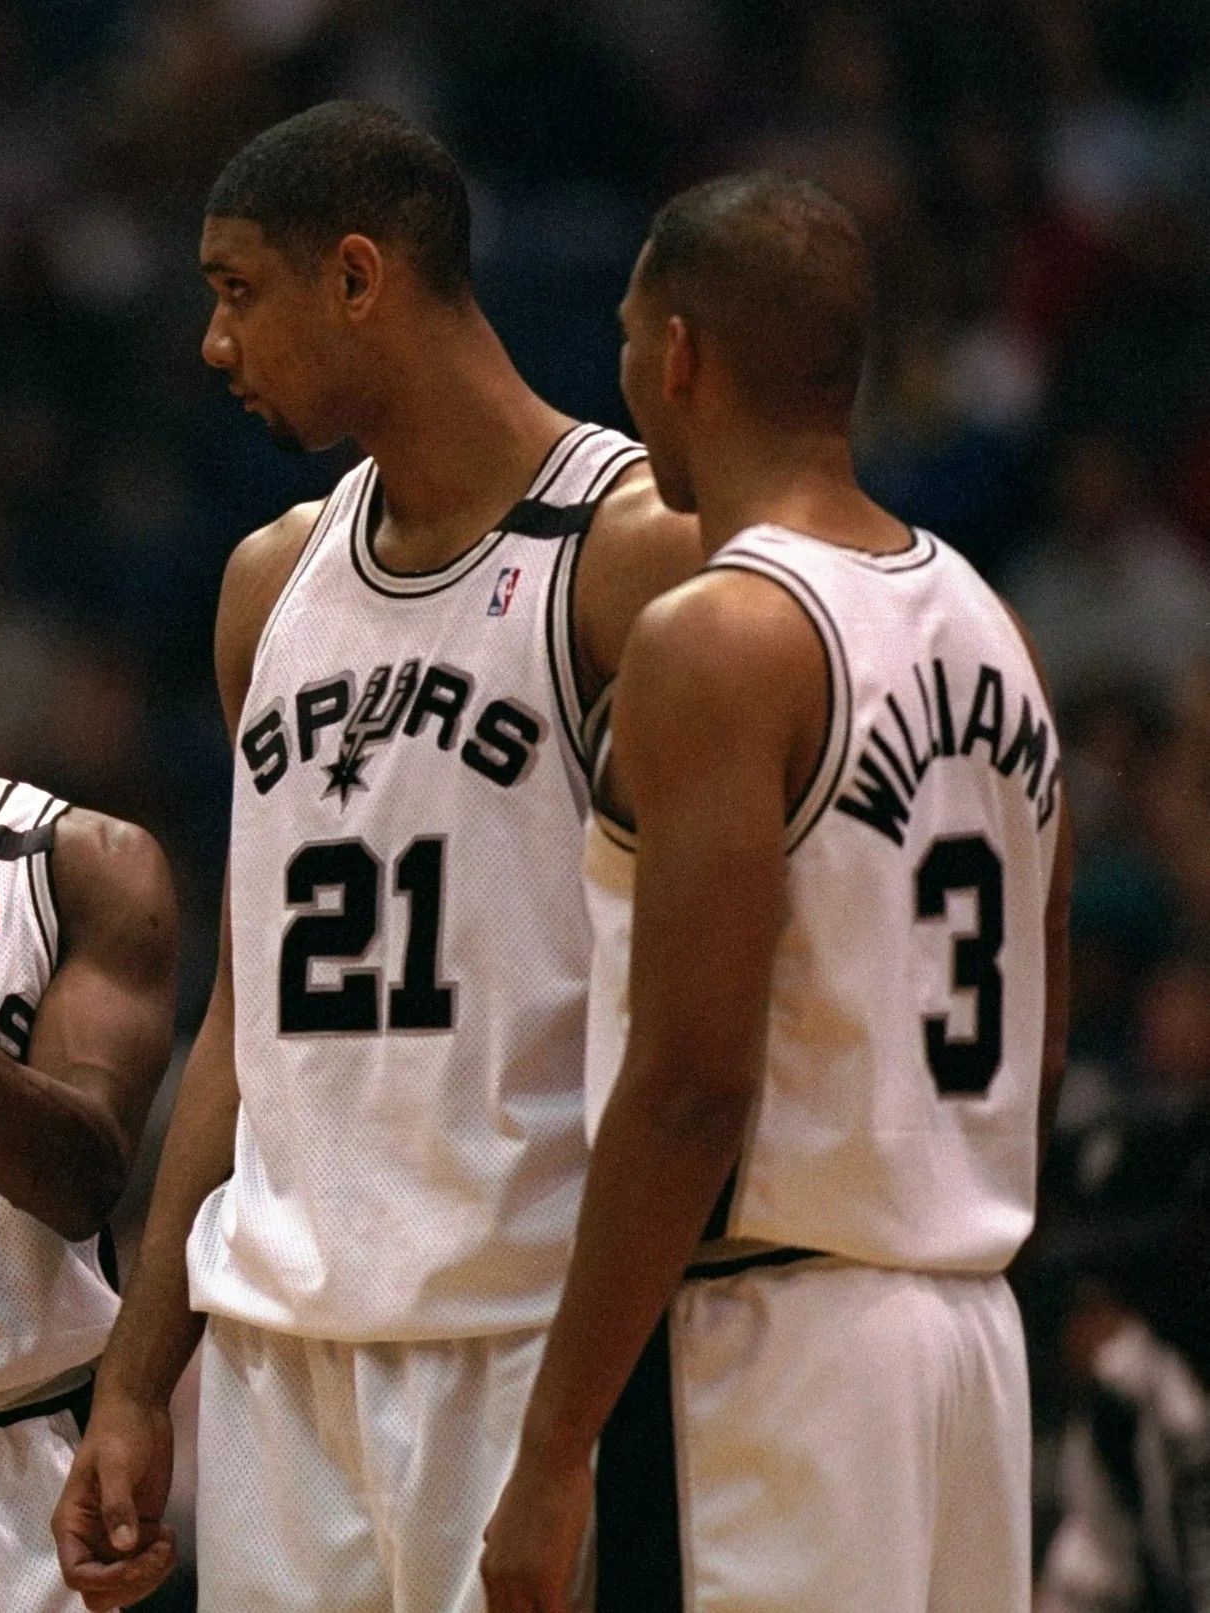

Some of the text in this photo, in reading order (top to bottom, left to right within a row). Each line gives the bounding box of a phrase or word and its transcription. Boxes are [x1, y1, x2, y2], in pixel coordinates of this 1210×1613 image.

[241, 658, 547, 812] SPURS
[834, 658, 1061, 848] WILLIAMS
[277, 833, 459, 1039] 21
[912, 831, 1004, 1101] 3
